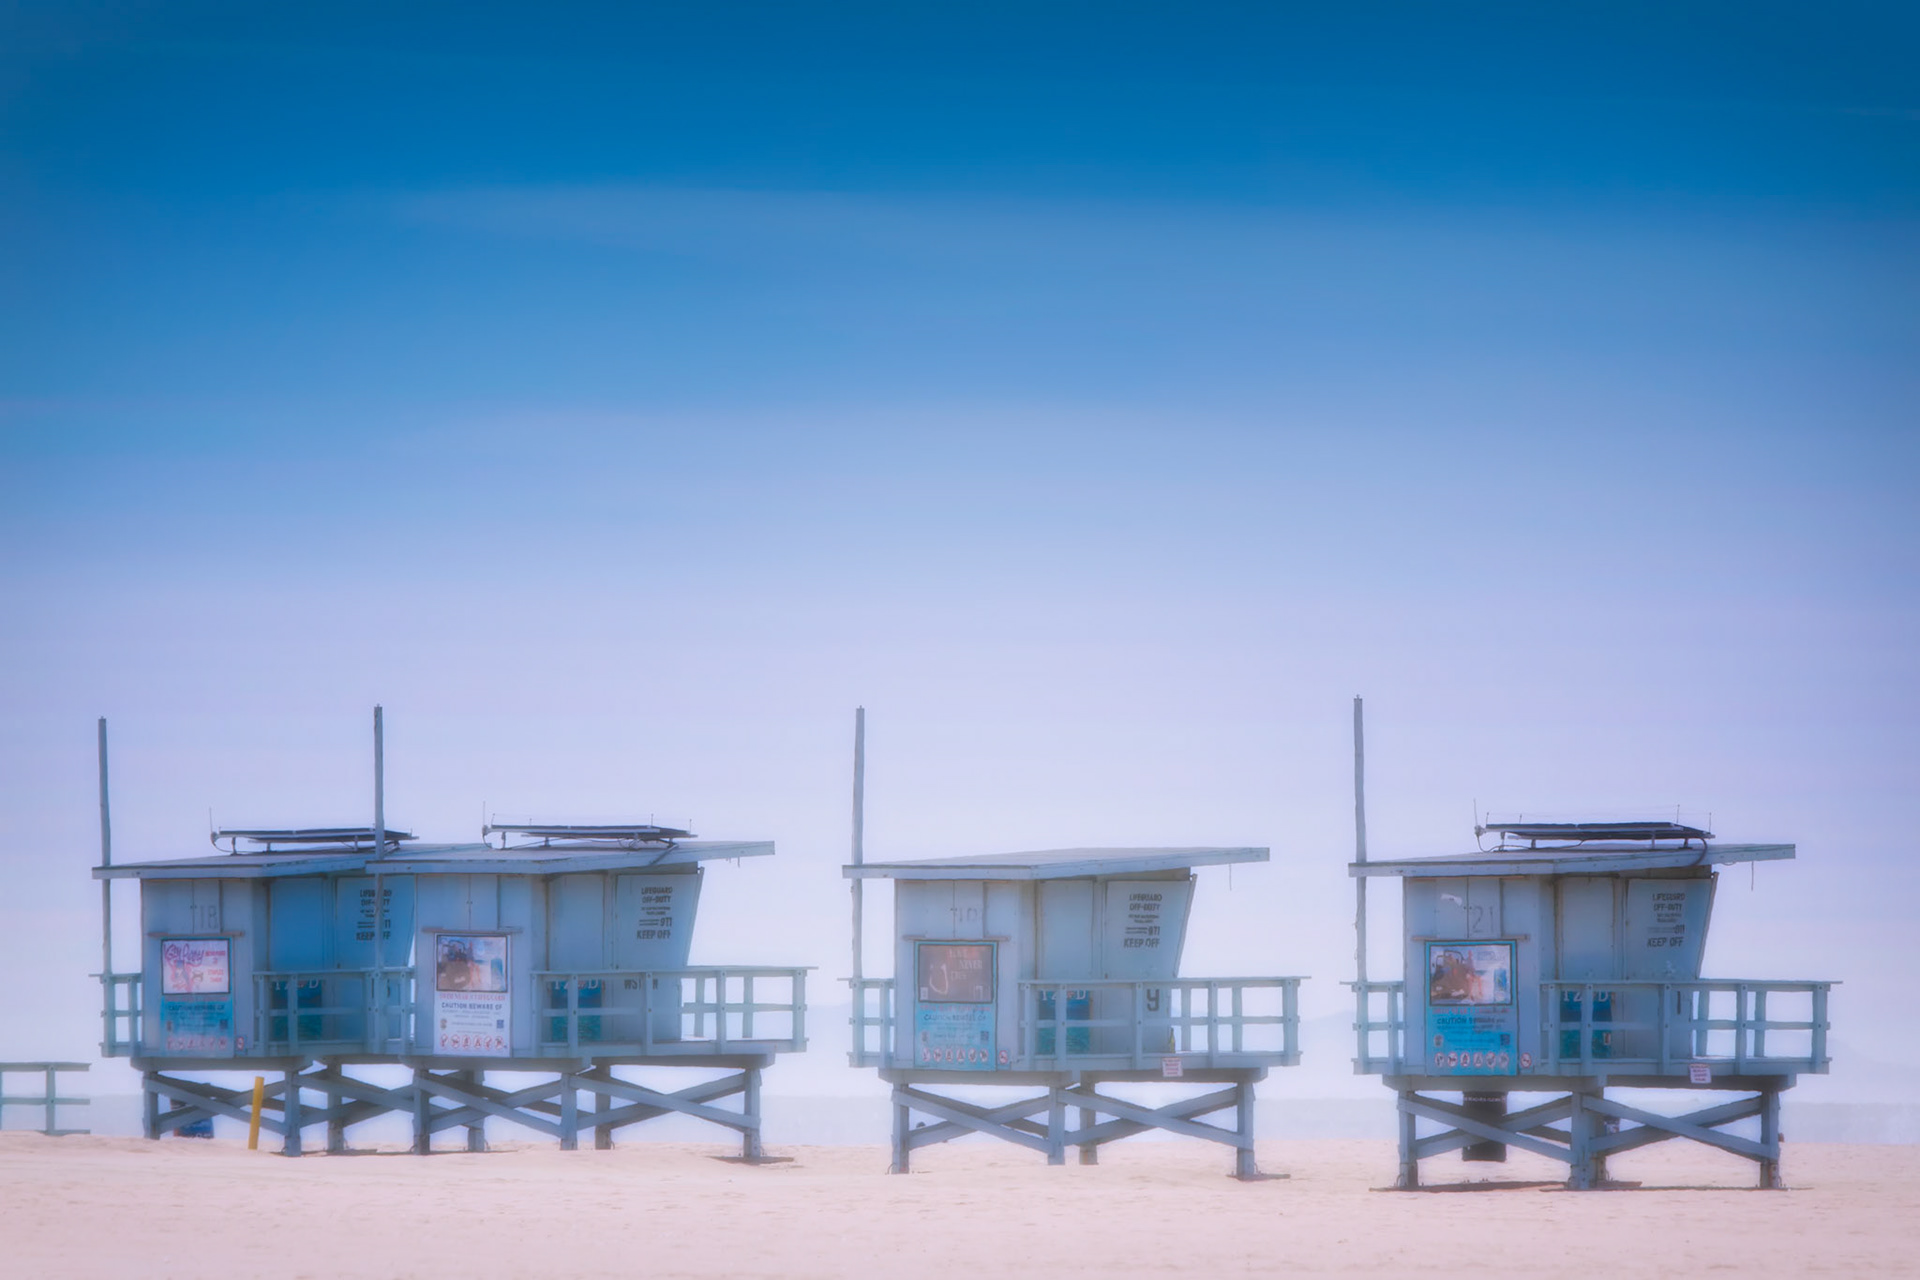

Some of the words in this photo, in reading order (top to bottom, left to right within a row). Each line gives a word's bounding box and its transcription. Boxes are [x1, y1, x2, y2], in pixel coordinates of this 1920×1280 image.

[360, 889, 392, 897] LIFEGRD
[641, 887, 673, 895] LIFEGUARD
[1129, 893, 1162, 901] LIFEGUARD
[660, 917, 672, 926] 911
[637, 930, 655, 939] KEEP
[657, 930, 671, 939] OFF
[1124, 938, 1144, 948] KEEP
[1145, 938, 1160, 948] OFF
[1647, 938, 1666, 947] KEEP
[1669, 937, 1684, 947] OFF
